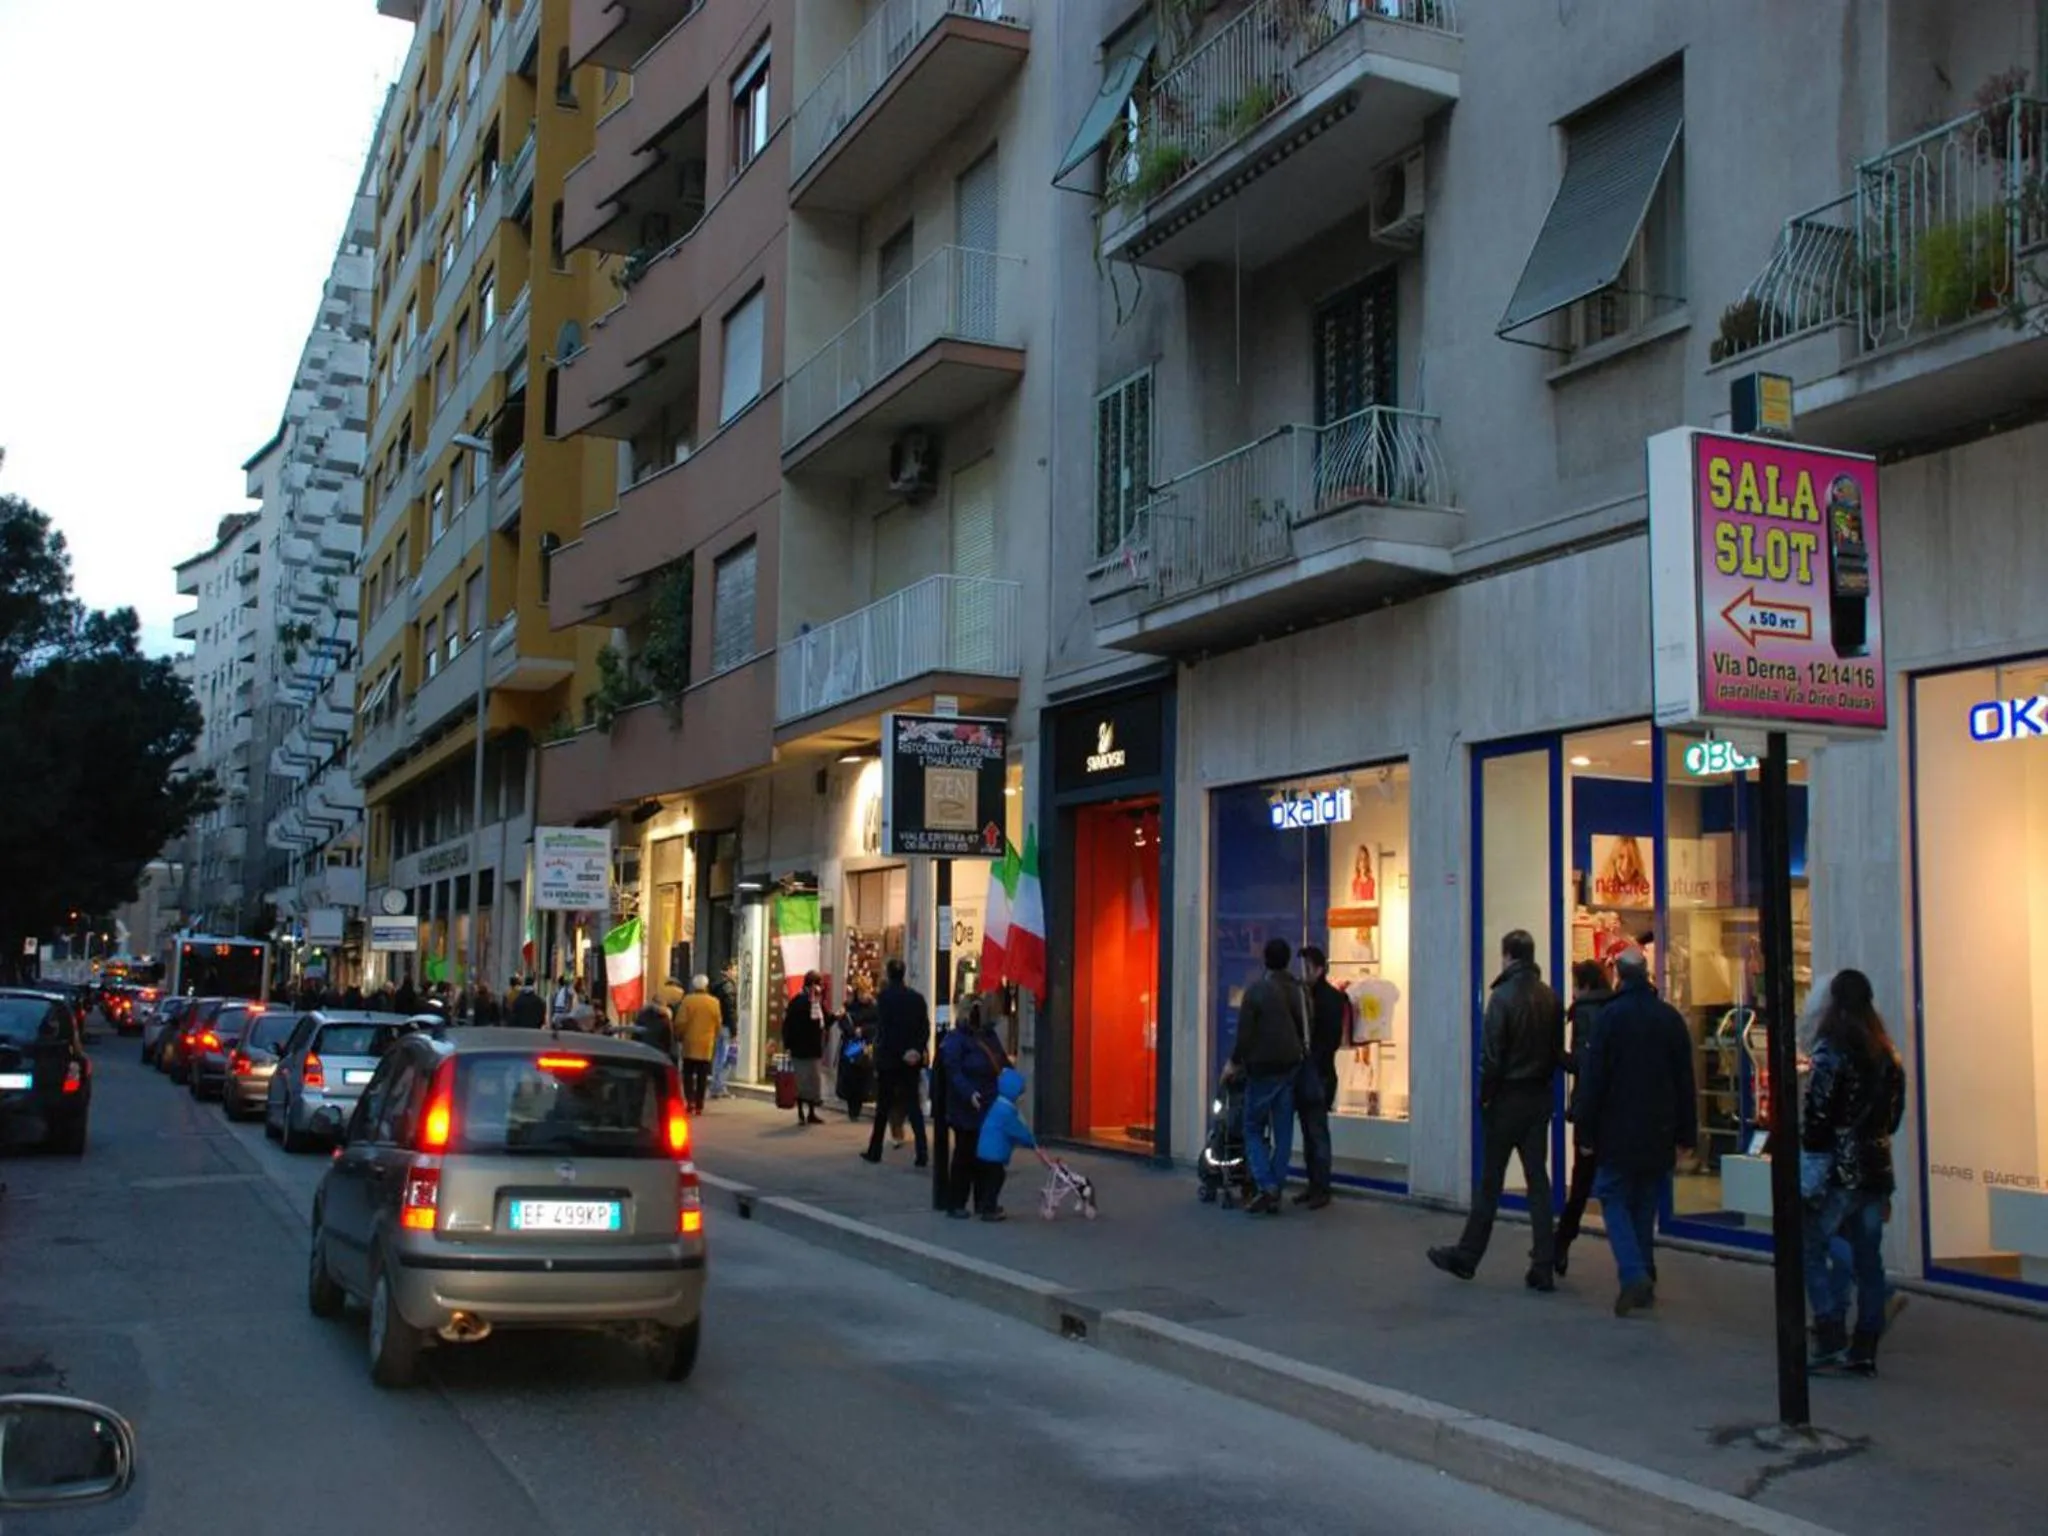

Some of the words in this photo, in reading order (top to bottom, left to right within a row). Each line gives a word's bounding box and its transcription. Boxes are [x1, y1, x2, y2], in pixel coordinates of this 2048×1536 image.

[1708, 455, 1821, 523] SALA
[1714, 520, 1818, 585] SLOT
[1748, 614, 1758, 625] A
[1759, 611, 1777, 627] 50
[1780, 618, 1797, 629] MT
[1712, 651, 1741, 675] Via
[1746, 656, 1802, 682] Derna,
[1970, 695, 2048, 742] OK
[932, 775, 969, 799] ZEN
[1930, 1164, 1974, 1180] PARIS
